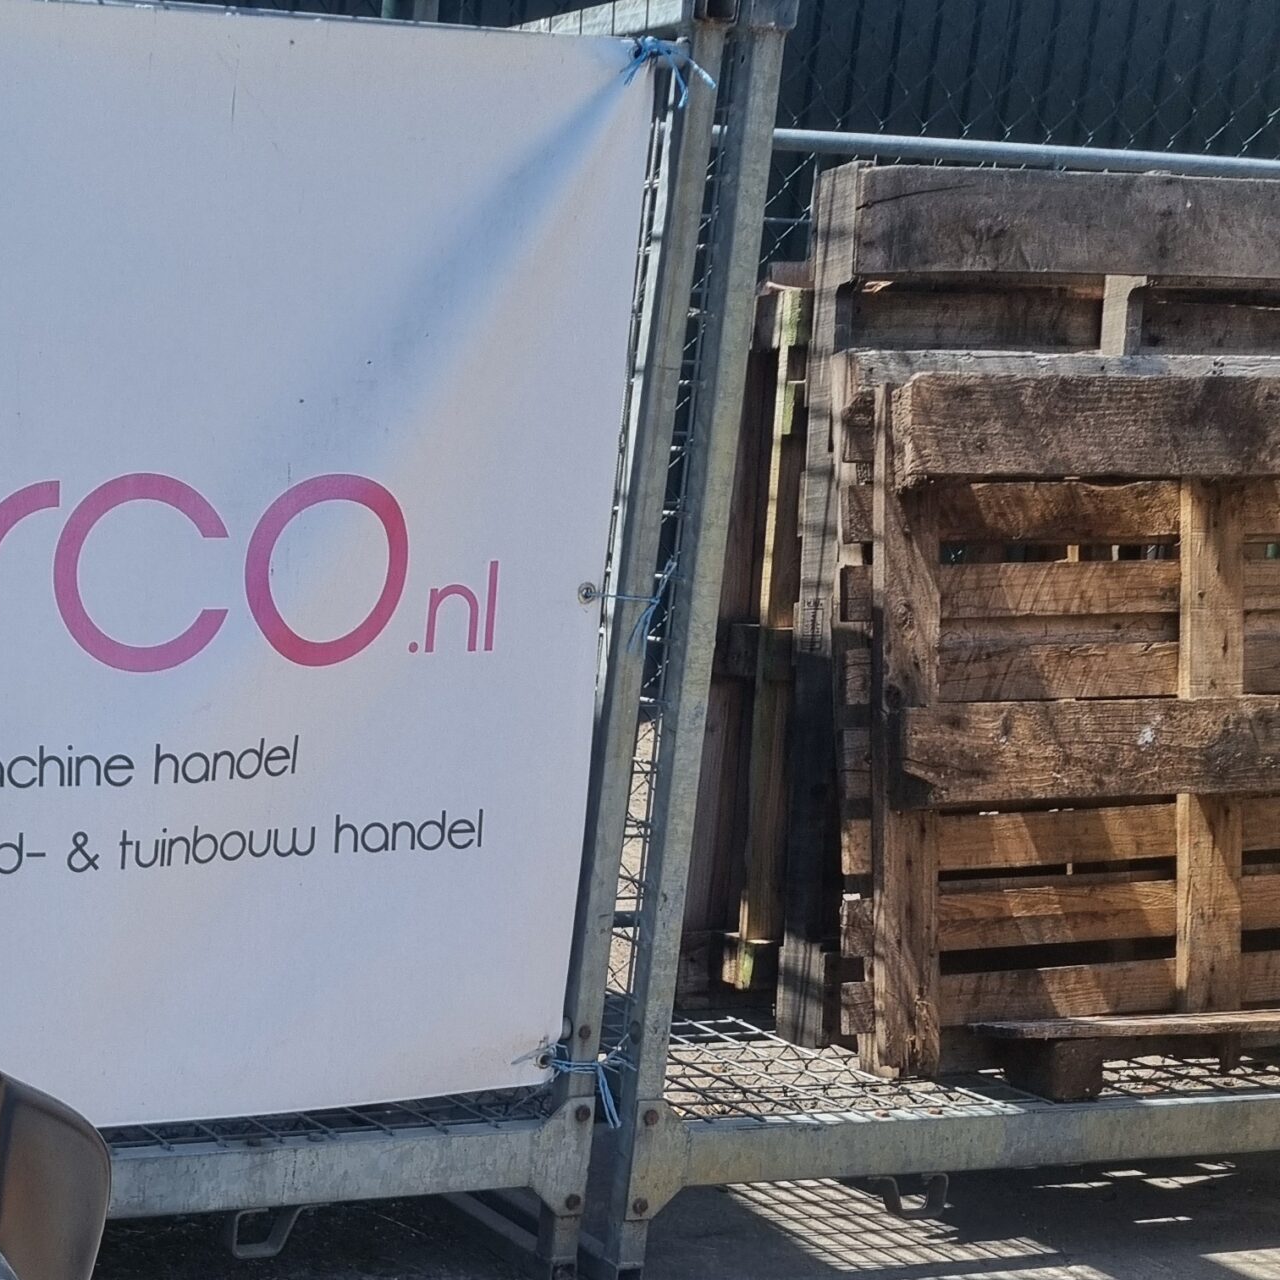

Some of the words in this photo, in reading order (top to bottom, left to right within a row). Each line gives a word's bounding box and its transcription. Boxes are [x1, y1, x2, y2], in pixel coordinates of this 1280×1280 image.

[153, 734, 300, 785] handel
[66, 831, 100, 874] &
[118, 825, 316, 871] tuinbouw
[333, 808, 484, 854] handel
